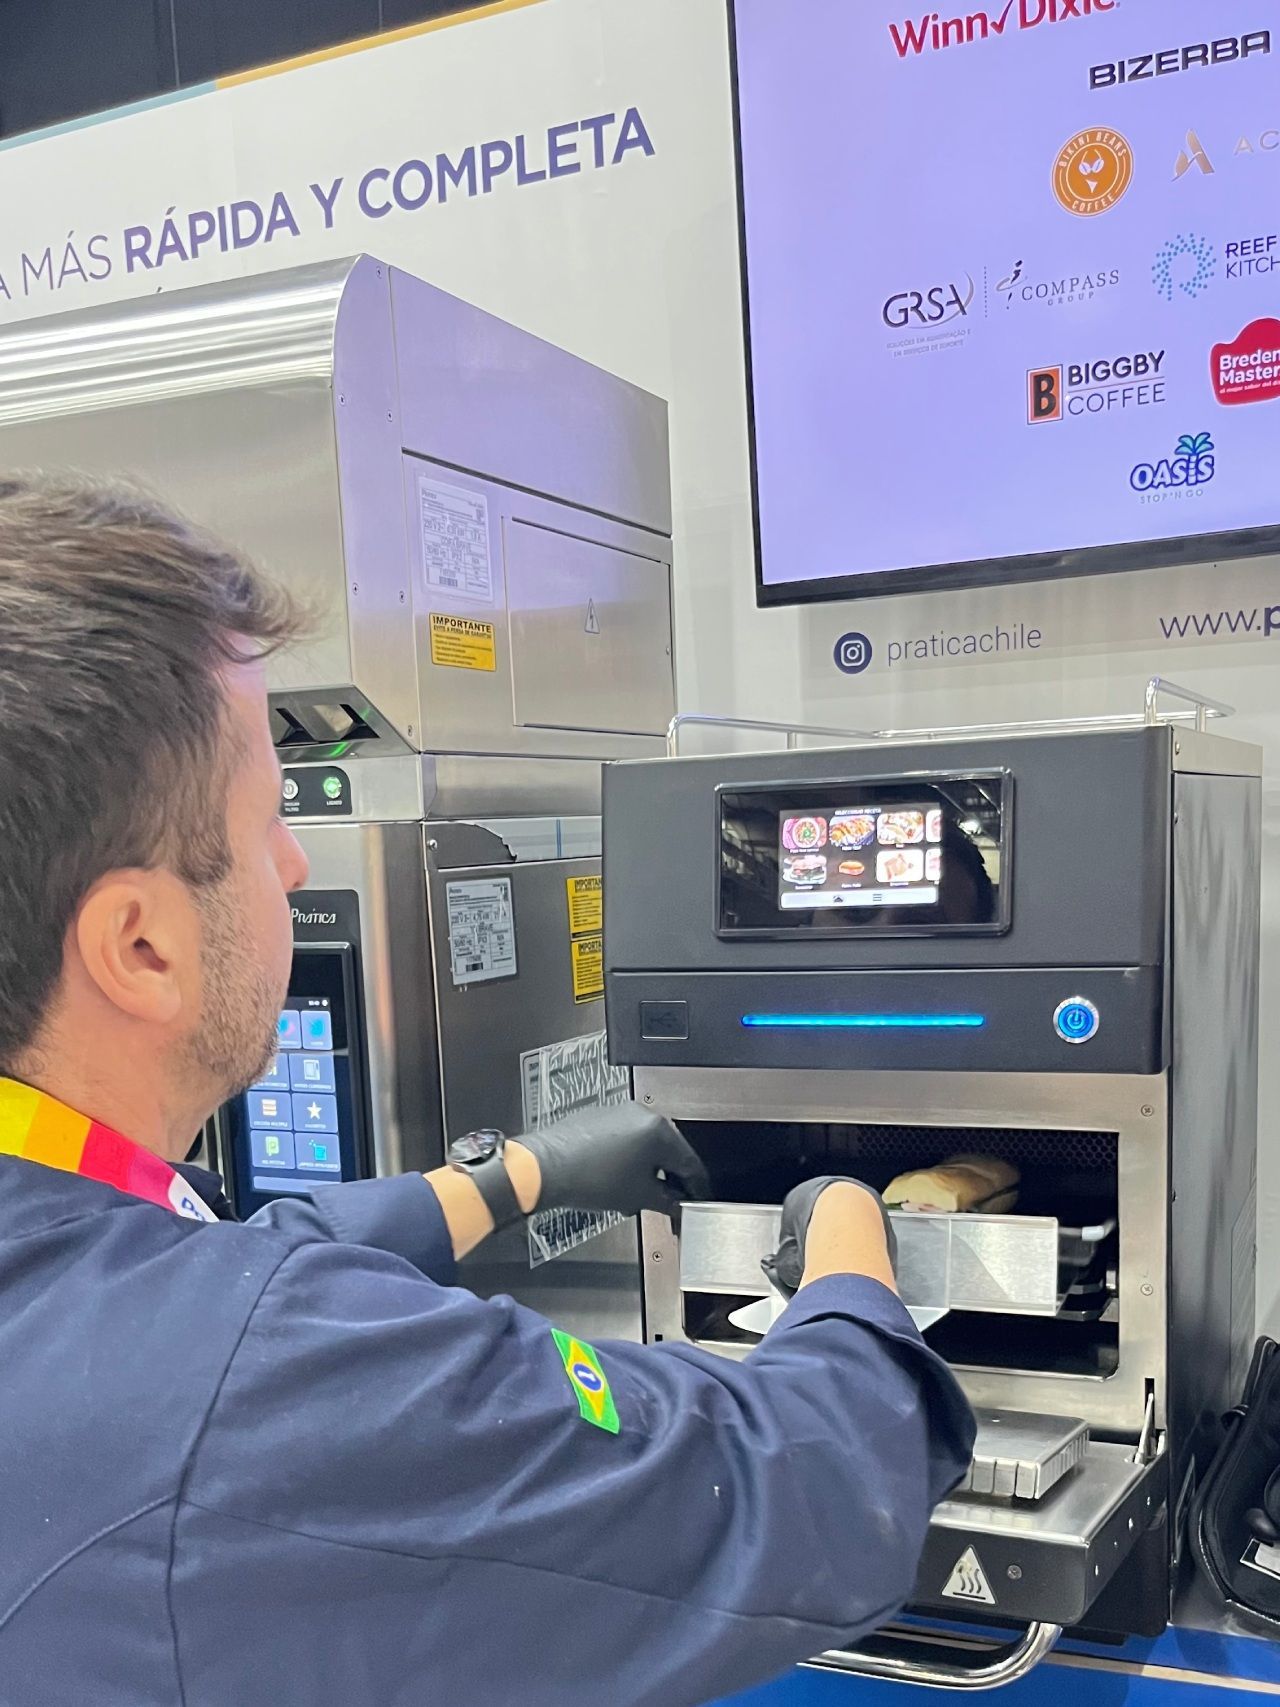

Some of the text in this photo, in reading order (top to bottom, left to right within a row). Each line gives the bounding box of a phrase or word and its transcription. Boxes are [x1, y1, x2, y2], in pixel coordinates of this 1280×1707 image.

[888, 12, 989, 58] Winn
[1089, 30, 1271, 90] BIZERBA
[1058, 133, 1090, 168] BIKINI
[21, 230, 112, 296] MÁS
[123, 191, 300, 274] RÁPIDA
[310, 177, 344, 229] Y
[358, 106, 656, 219] COMPLETA
[1071, 192, 1115, 212] COFFEE
[1225, 235, 1277, 259] REEF
[1021, 269, 1120, 301] COMPASS
[1047, 291, 1095, 306] GROUP
[882, 283, 969, 329] GRSA
[1068, 349, 1166, 388] BIGGBY
[1219, 348, 1280, 371] Breden
[1033, 373, 1057, 418] B
[1068, 382, 1166, 416] COFFEE
[1130, 454, 1215, 492] OASIS
[432, 615, 492, 633] IMPORTANTE
[887, 623, 1043, 667] praticachile
